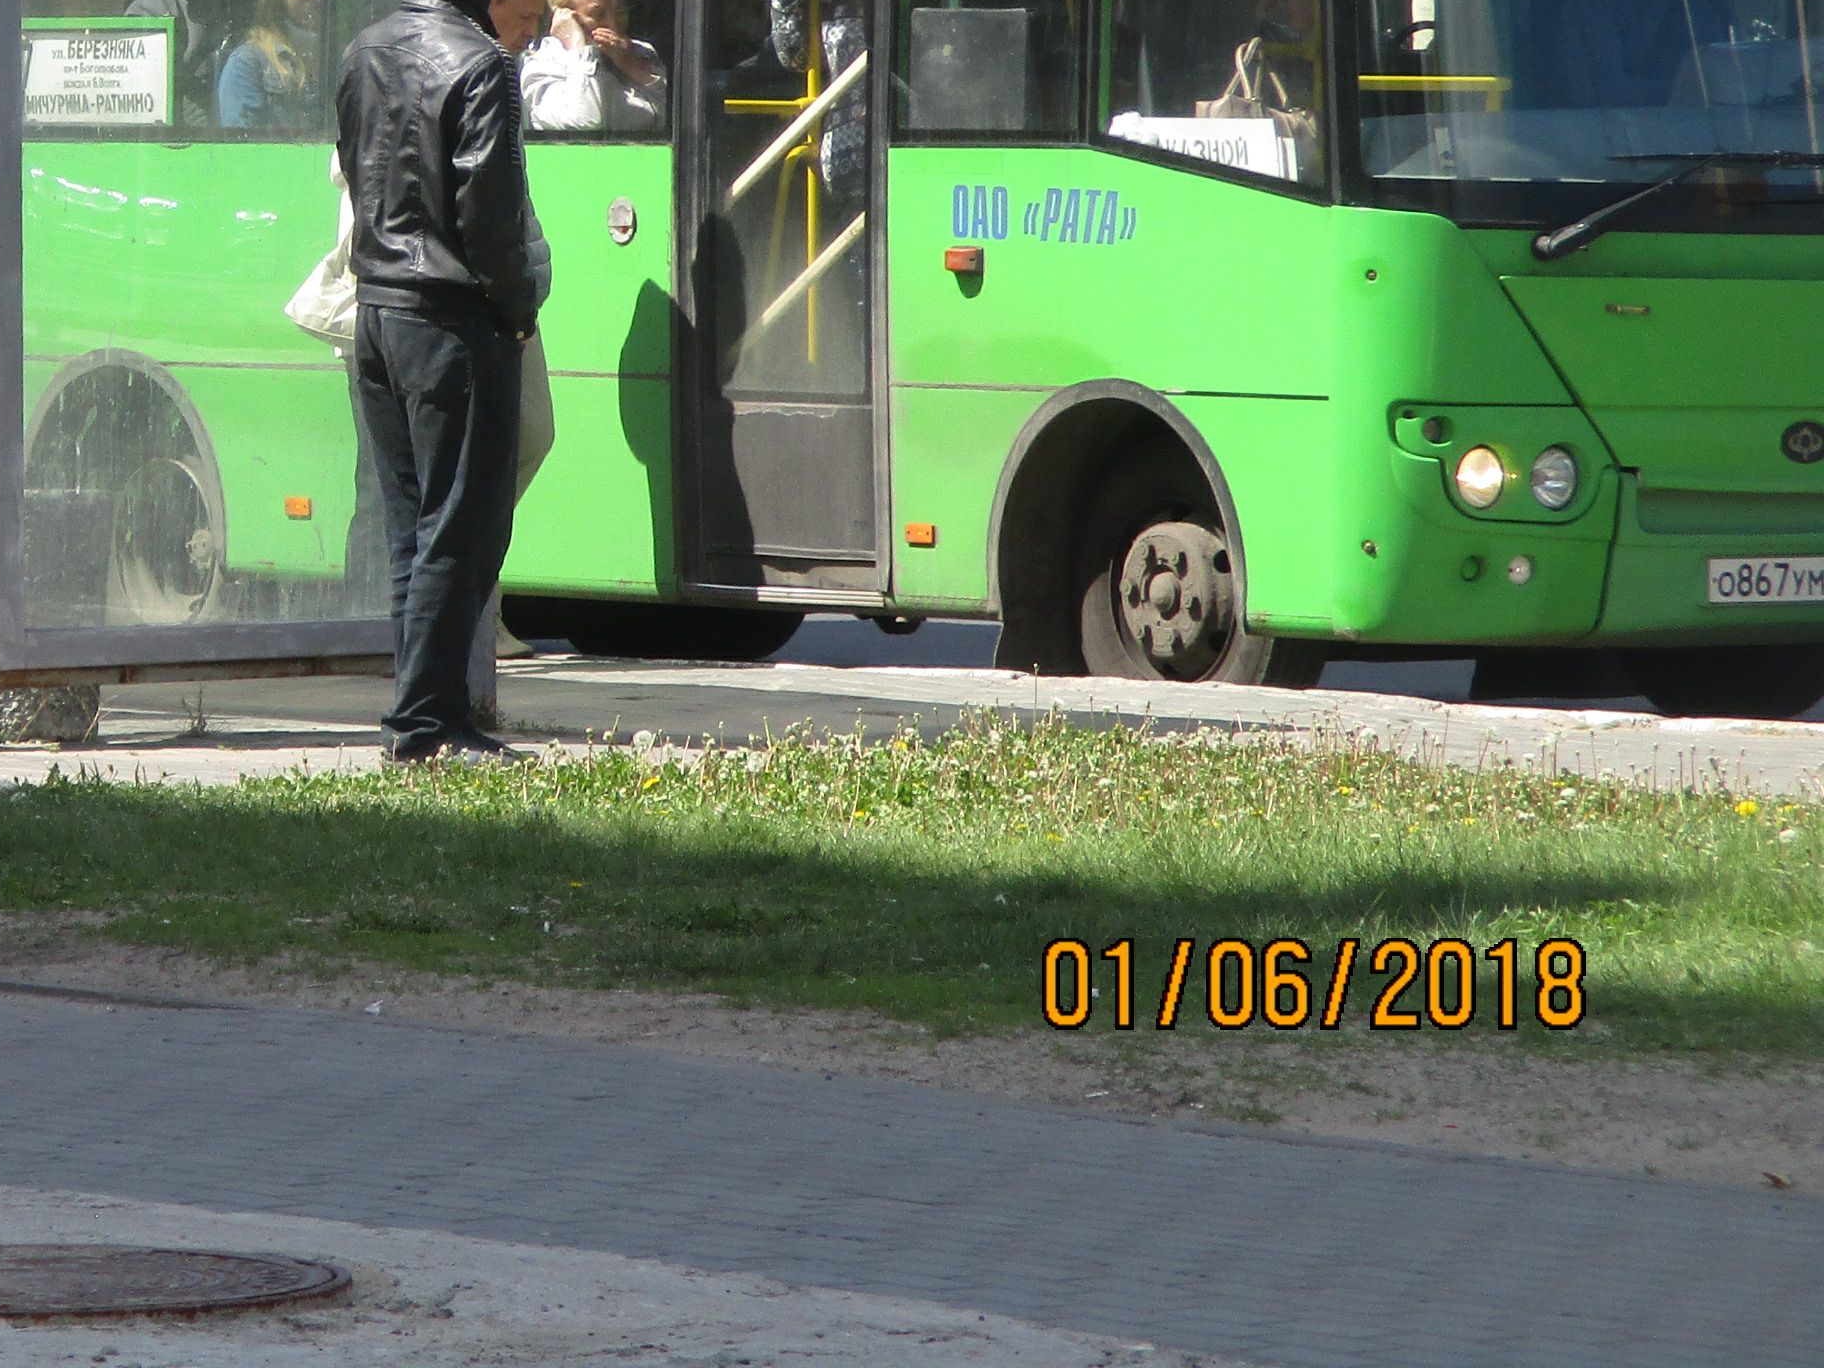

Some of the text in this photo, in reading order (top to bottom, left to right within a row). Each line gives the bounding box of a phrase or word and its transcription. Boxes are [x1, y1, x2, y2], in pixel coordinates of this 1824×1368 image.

[51, 39, 147, 60] ул. БЕРЕЗНЯКА
[953, 184, 1136, 245] ОАО «РАТА»
